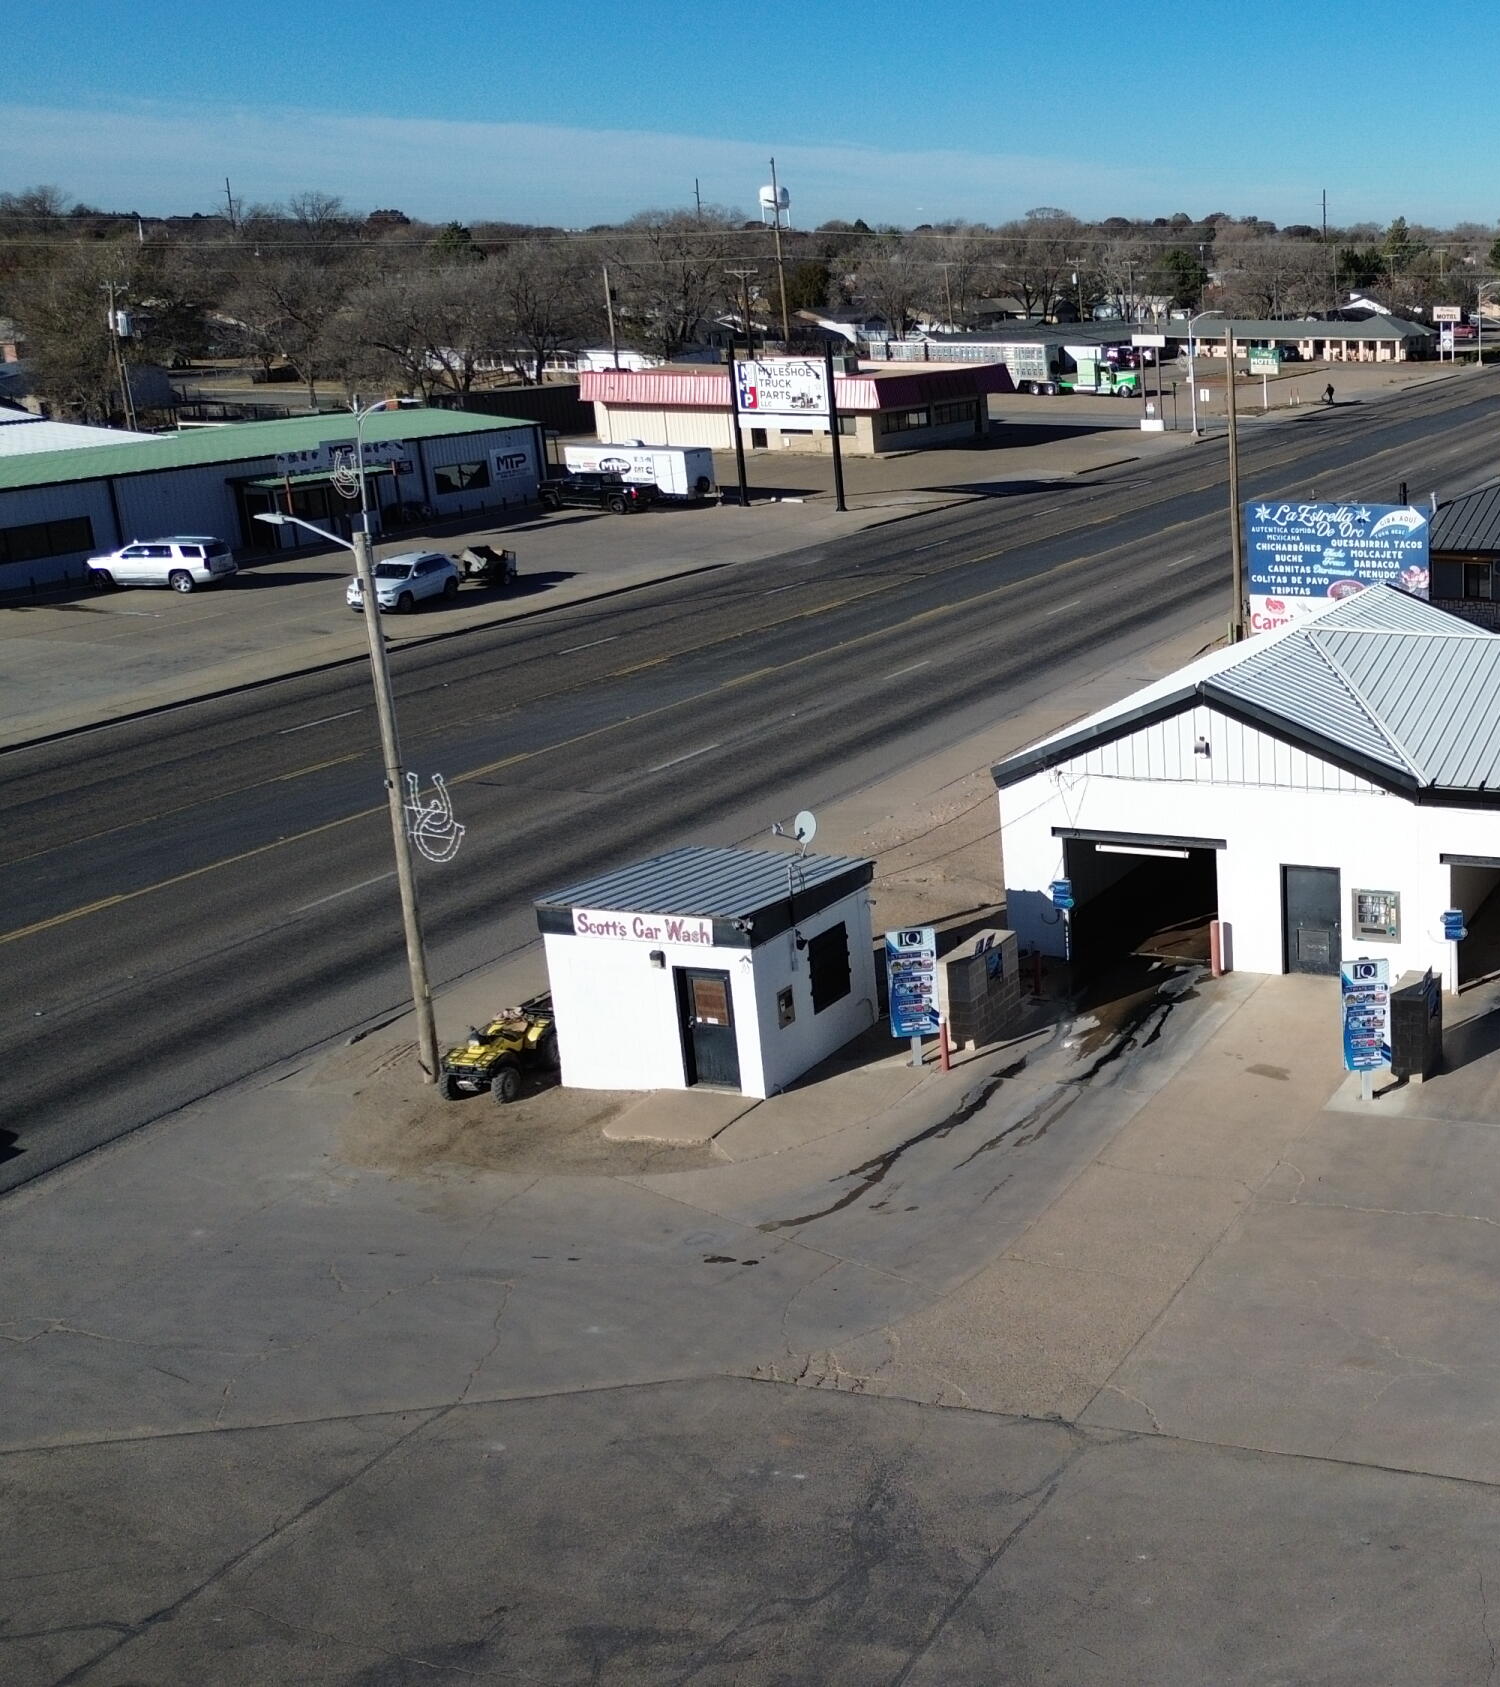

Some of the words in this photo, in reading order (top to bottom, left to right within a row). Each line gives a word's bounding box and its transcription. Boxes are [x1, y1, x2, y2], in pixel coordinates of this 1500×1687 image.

[1251, 357, 1278, 365] MOTEL
[758, 367, 811, 377] MULESHOE
[759, 379, 792, 388] TRUCK
[759, 391, 791, 400] PARTS
[328, 444, 354, 458] MTP
[495, 453, 527, 471] MTP
[601, 461, 630, 471] MTP
[1271, 504, 1298, 527] La
[1298, 504, 1354, 527] Estrella
[1251, 526, 1288, 534] AUTENTICA
[1316, 520, 1336, 537] De
[1338, 520, 1365, 538] Oro
[1330, 539, 1390, 549] QUESABIRRIA
[1394, 540, 1423, 549] TACOS
[1274, 554, 1304, 563] BUCHE
[1350, 549, 1404, 559] MOLCAJETE
[1267, 564, 1312, 574] CARNITAS
[1353, 559, 1401, 569] BARBACOA
[1358, 569, 1396, 579] MENUDO
[1251, 574, 1288, 583] COLITAS
[1291, 576, 1303, 585] DE
[1306, 576, 1330, 585] PAVO
[1270, 586, 1311, 595] TRIPITAS
[1251, 613, 1294, 631] Car
[577, 913, 628, 937] Scott's
[632, 916, 662, 940] Car
[664, 918, 711, 945] Wash
[901, 932, 921, 946] IQ
[1356, 964, 1375, 979] IQ
